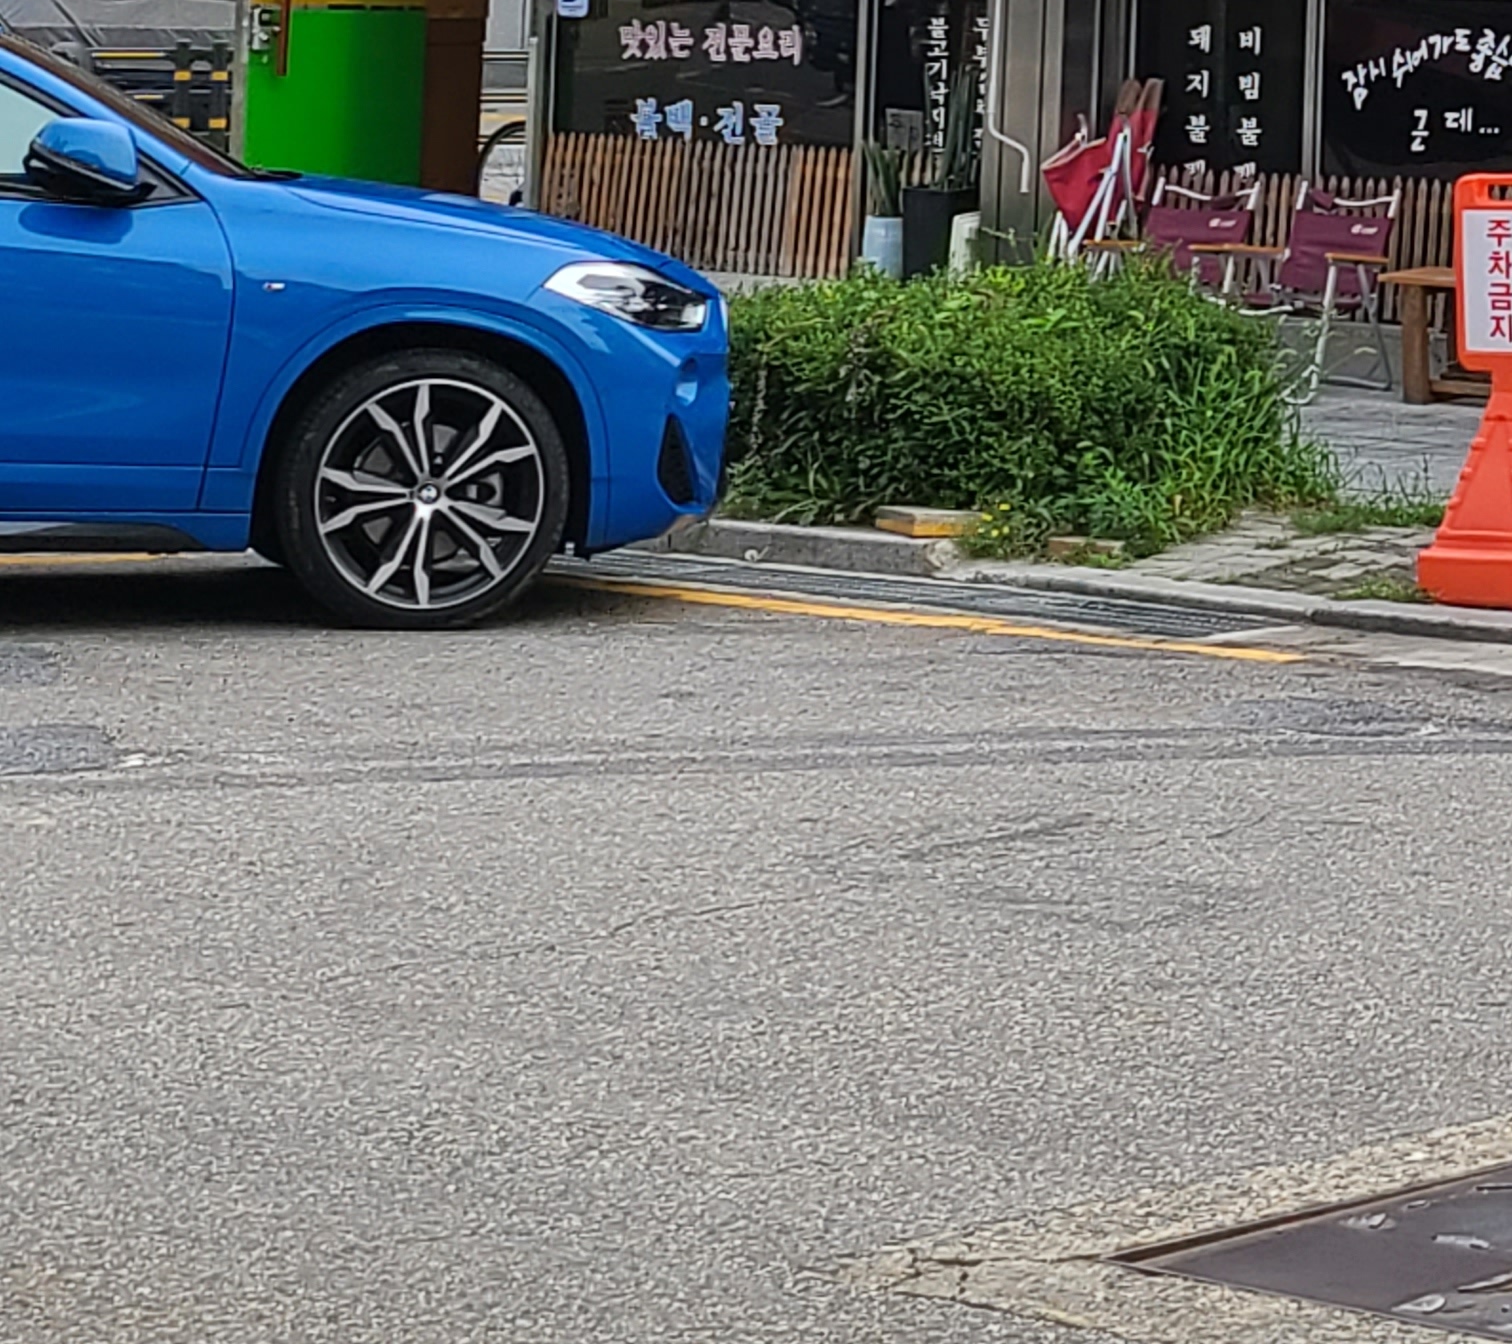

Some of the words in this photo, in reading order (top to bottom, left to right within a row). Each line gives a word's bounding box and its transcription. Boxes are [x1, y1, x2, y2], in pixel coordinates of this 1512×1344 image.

[618, 18, 694, 60] 맛있는
[701, 22, 803, 66] 전문요리
[1341, 57, 1387, 111] 잠시
